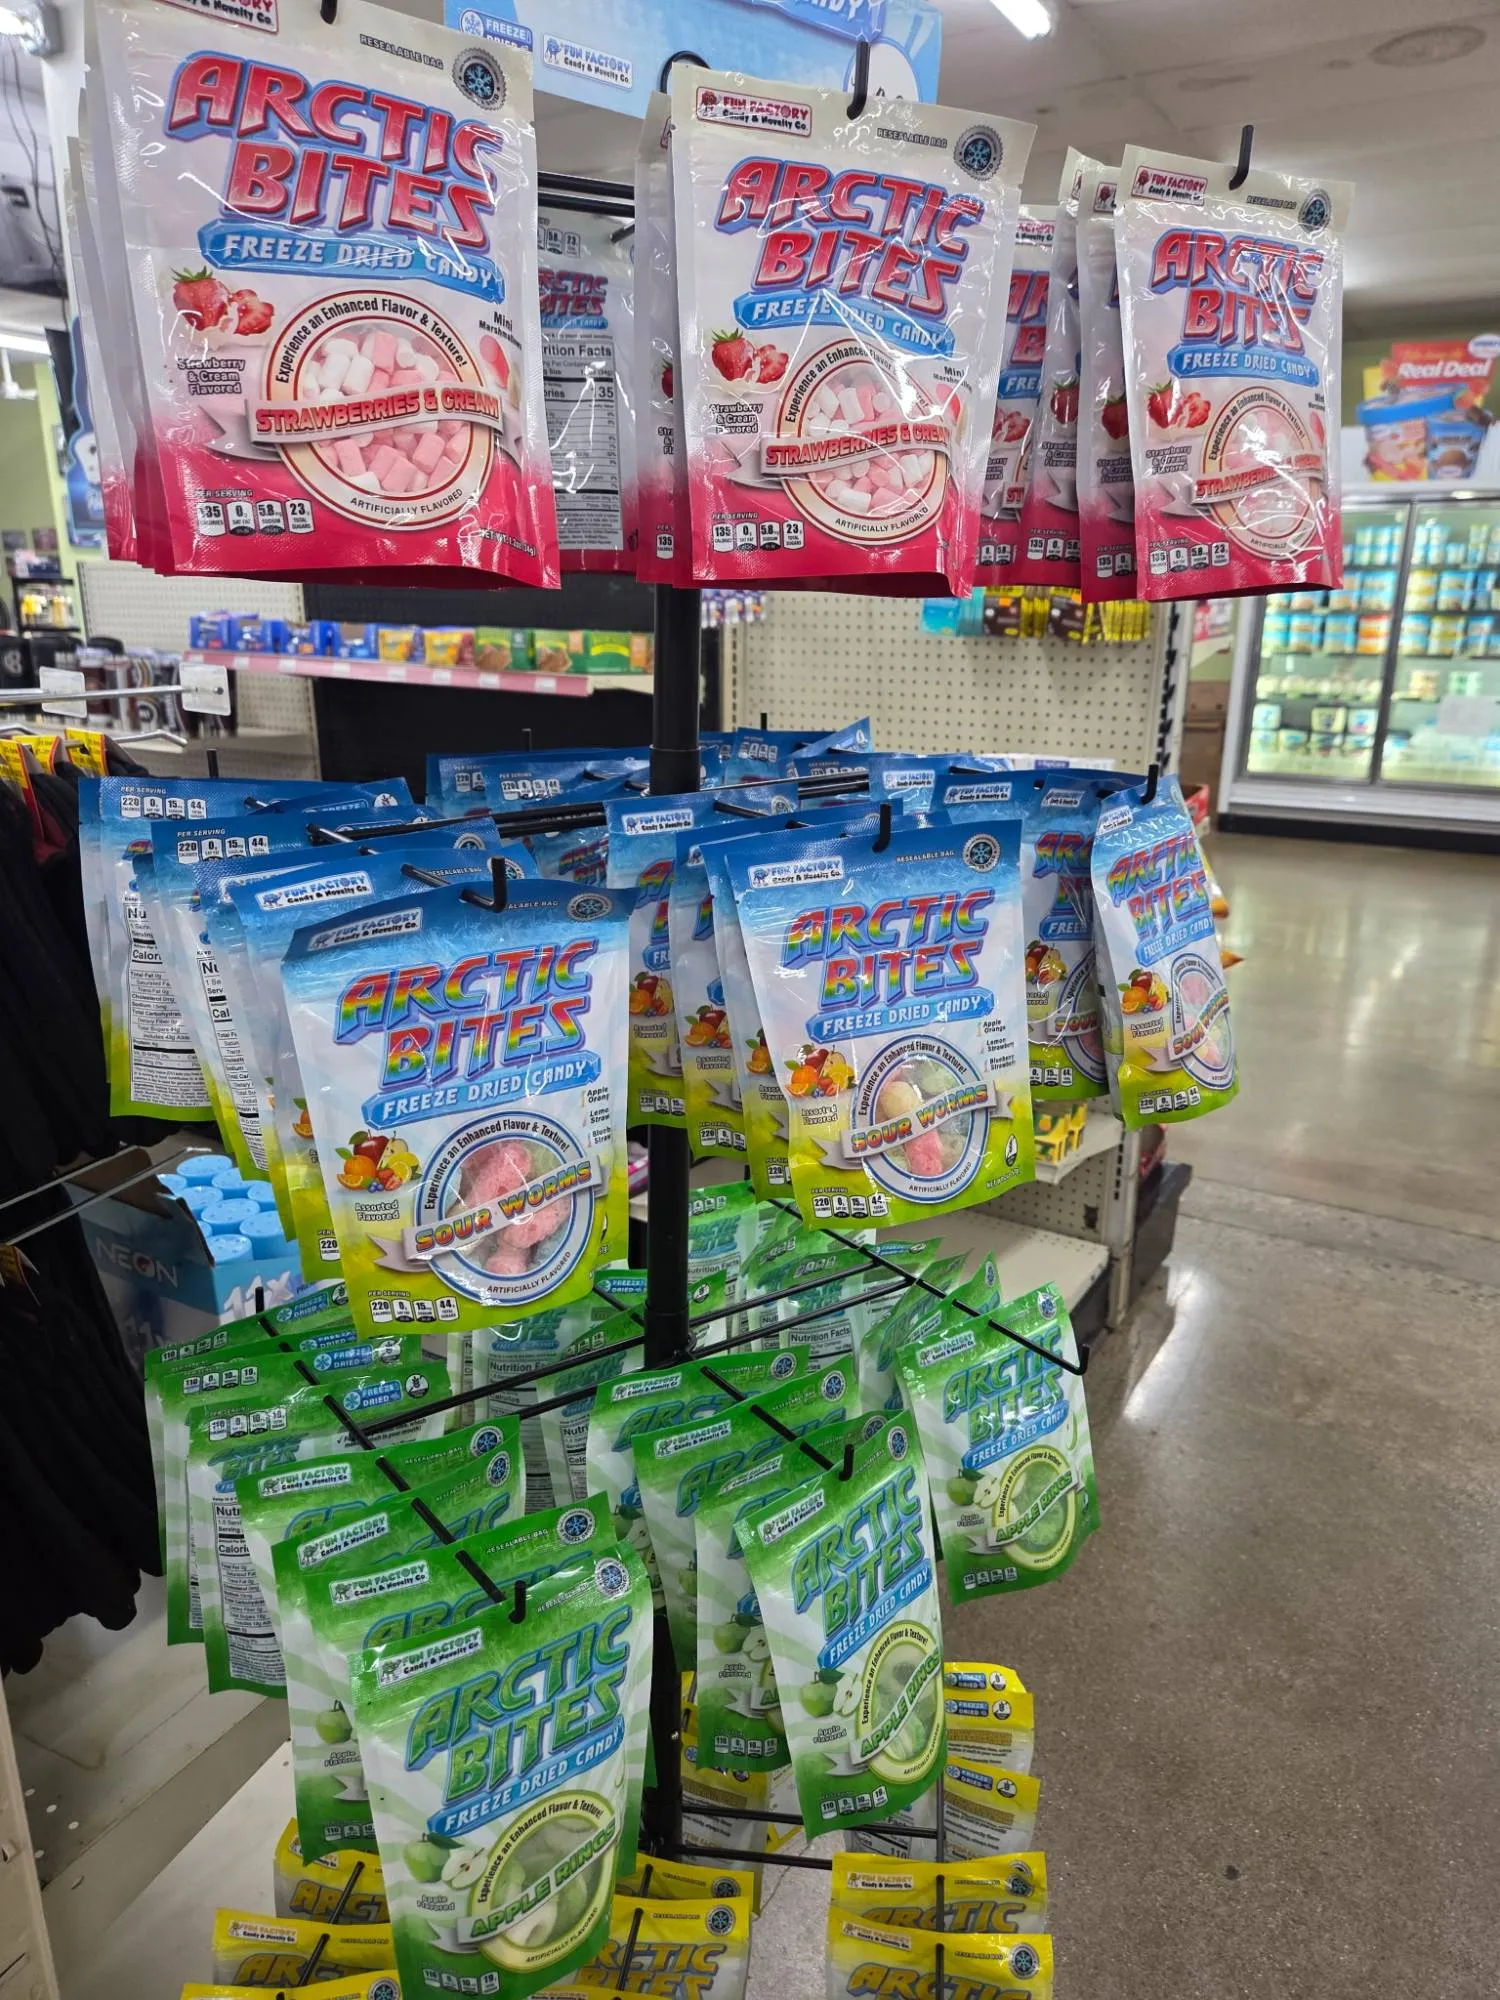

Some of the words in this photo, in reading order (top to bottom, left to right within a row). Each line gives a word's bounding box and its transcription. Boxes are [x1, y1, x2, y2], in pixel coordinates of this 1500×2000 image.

[485, 17, 528, 41] FREEZE
[360, 33, 422, 62] RESEALABLE
[423, 56, 444, 70] BAG
[563, 45, 583, 59] FUN
[585, 51, 630, 73] FACTORY
[564, 57, 585, 70] Candy
[594, 66, 618, 80] Novelty
[164, 49, 507, 187] ARCTIC
[762, 116, 792, 129] Novelty
[877, 128, 928, 147] RESEALABLE
[220, 137, 501, 256] BITES
[1151, 173, 1168, 185] FUN
[1168, 176, 1205, 192] FACTORY
[714, 156, 985, 261] ARCTIC
[223, 233, 325, 264] FREEZE
[336, 242, 415, 271] DRIED
[424, 256, 495, 288] CANDY
[750, 230, 961, 319] BITES
[1151, 227, 1326, 301] ARCTIC
[493, 311, 513, 332] Mini
[753, 298, 832, 320] FREEZE
[839, 306, 886, 329] DRIED
[892, 317, 946, 349] CANDY
[1182, 288, 1312, 355] BITES
[275, 325, 311, 384] Experience
[311, 314, 325, 329] an
[324, 298, 379, 320] Enhanced
[381, 298, 419, 320] Flavor
[429, 319, 468, 368] Texture!
[200, 370, 240, 382] Cream
[1181, 352, 1239, 368] FREEZE
[1244, 353, 1277, 371] DRIED
[1281, 360, 1313, 377] CANDY
[1398, 359, 1444, 379] Real
[1443, 358, 1493, 378] Deal
[188, 382, 242, 395] Flavored
[785, 368, 817, 424] Experience
[816, 358, 828, 373] an
[255, 389, 420, 435] STRAWBERRIES
[423, 389, 439, 412] &
[440, 386, 500, 420] CREAM
[710, 403, 763, 414] Strawberry
[726, 414, 757, 424] Cream
[765, 425, 898, 467] STRAWBERRIES
[901, 422, 911, 442] &
[1208, 412, 1232, 461] Experience
[215, 489, 253, 498] SERVING
[350, 496, 418, 516] ARTIFICIALLY
[420, 488, 464, 514] FLAVORED
[835, 518, 889, 533] ARTIFICIALLY
[136, 787, 167, 795] SERVING
[177, 830, 191, 838] PER
[193, 828, 226, 837] SERVING
[179, 841, 198, 852] 220
[896, 852, 938, 863] RESEALABLE
[939, 849, 955, 858] BAG
[283, 887, 305, 899] FUN
[305, 876, 366, 895] FACTORY
[286, 894, 313, 904] Candy
[324, 885, 358, 898] Novelty
[333, 933, 357, 944] Candy
[371, 924, 404, 938] Novelty
[356, 910, 420, 931] FACTORY
[782, 887, 996, 970] ARCTIC
[333, 937, 599, 1045] ARCTIC
[818, 939, 984, 1012] BITES
[822, 1013, 882, 1037] FREEZE
[888, 1006, 930, 1023] DRIED
[936, 995, 981, 1020] CANDY
[983, 1019, 1002, 1028] Apple
[380, 993, 592, 1091] BITES
[986, 1037, 1007, 1046] Lemon
[382, 1088, 458, 1120] FREEZE
[467, 1076, 522, 1102] DRIED
[531, 1060, 586, 1089] CANDY
[858, 1071, 880, 1116] Experience
[884, 1042, 915, 1063] Enhanced
[915, 1041, 936, 1052] Flavor
[941, 1048, 968, 1076] Texture!
[850, 1117, 914, 1152] SOUR
[915, 1082, 989, 1130] WORMS
[424, 1158, 451, 1211] Experience
[448, 1145, 461, 1160] an
[456, 1120, 502, 1148] Enhanced
[503, 1119, 532, 1131] Flavor
[541, 1124, 571, 1153] Texture!
[909, 1182, 950, 1193] ARTIFICIALLY
[950, 1161, 972, 1188] FLAVORED
[354, 1200, 398, 1214] Assorted
[357, 1210, 400, 1222] Flavored
[415, 1208, 494, 1253] SOUR
[497, 1160, 593, 1218] WORMS
[95, 1236, 179, 1289] NEON
[486, 1278, 541, 1294] ARTIFICIALLY
[540, 1251, 572, 1285] FLAVORED
[372, 1302, 389, 1311] 220
[790, 1330, 832, 1344] Nutrition
[489, 1360, 533, 1373] Nutrition
[943, 1323, 1064, 1425] ARCTIC
[362, 1394, 389, 1406] DRIED
[969, 1366, 1065, 1449] BITES
[971, 1440, 1009, 1466] FREEZE
[1011, 1426, 1039, 1445] DRIED
[1040, 1410, 1066, 1435] CANDY
[280, 1473, 297, 1485] FUN
[298, 1465, 348, 1481] FACTORY
[280, 1481, 301, 1490] Candy
[311, 1476, 339, 1486] Novelty
[995, 1502, 1041, 1543] APPLE
[1039, 1470, 1074, 1511] RINGS
[998, 1482, 1012, 1518] Experience
[486, 1534, 531, 1554] RESEALABLE
[532, 1527, 548, 1538] BAG
[791, 1464, 922, 1615] ARCTIC
[352, 1579, 371, 1592] FUN
[372, 1563, 426, 1586] FACTORY
[354, 1586, 376, 1597] Candy
[388, 1576, 415, 1588] Novelty
[824, 1514, 925, 1640] BITES
[829, 1626, 867, 1668] FREEZE
[868, 1596, 897, 1628] DRIED
[900, 1567, 930, 1600] CANDY
[401, 1654, 424, 1667] FUN
[425, 1631, 480, 1658] FACTORY
[403, 1661, 428, 1675] Candy
[439, 1647, 468, 1663] Novelty
[404, 1604, 633, 1771] ARCTIC
[859, 1695, 908, 1758] APPLE
[905, 1648, 940, 1705] RINGS
[861, 1680, 874, 1725] Experience
[445, 1664, 627, 1804] BITES
[444, 1788, 512, 1832] FREEZE
[519, 1760, 569, 1794] DRIED
[575, 1726, 620, 1768] CANDY
[477, 1853, 505, 1904] Experience
[501, 1842, 513, 1855] an
[510, 1805, 548, 1844] Enhanced
[548, 1799, 572, 1815] Flavor
[579, 1798, 605, 1821] Texture!
[470, 1876, 551, 1939] APPLE
[554, 1820, 617, 1888] RINGS
[525, 1940, 572, 1963] ARTIFICIALLY
[571, 1906, 600, 1942] FLAVORED
